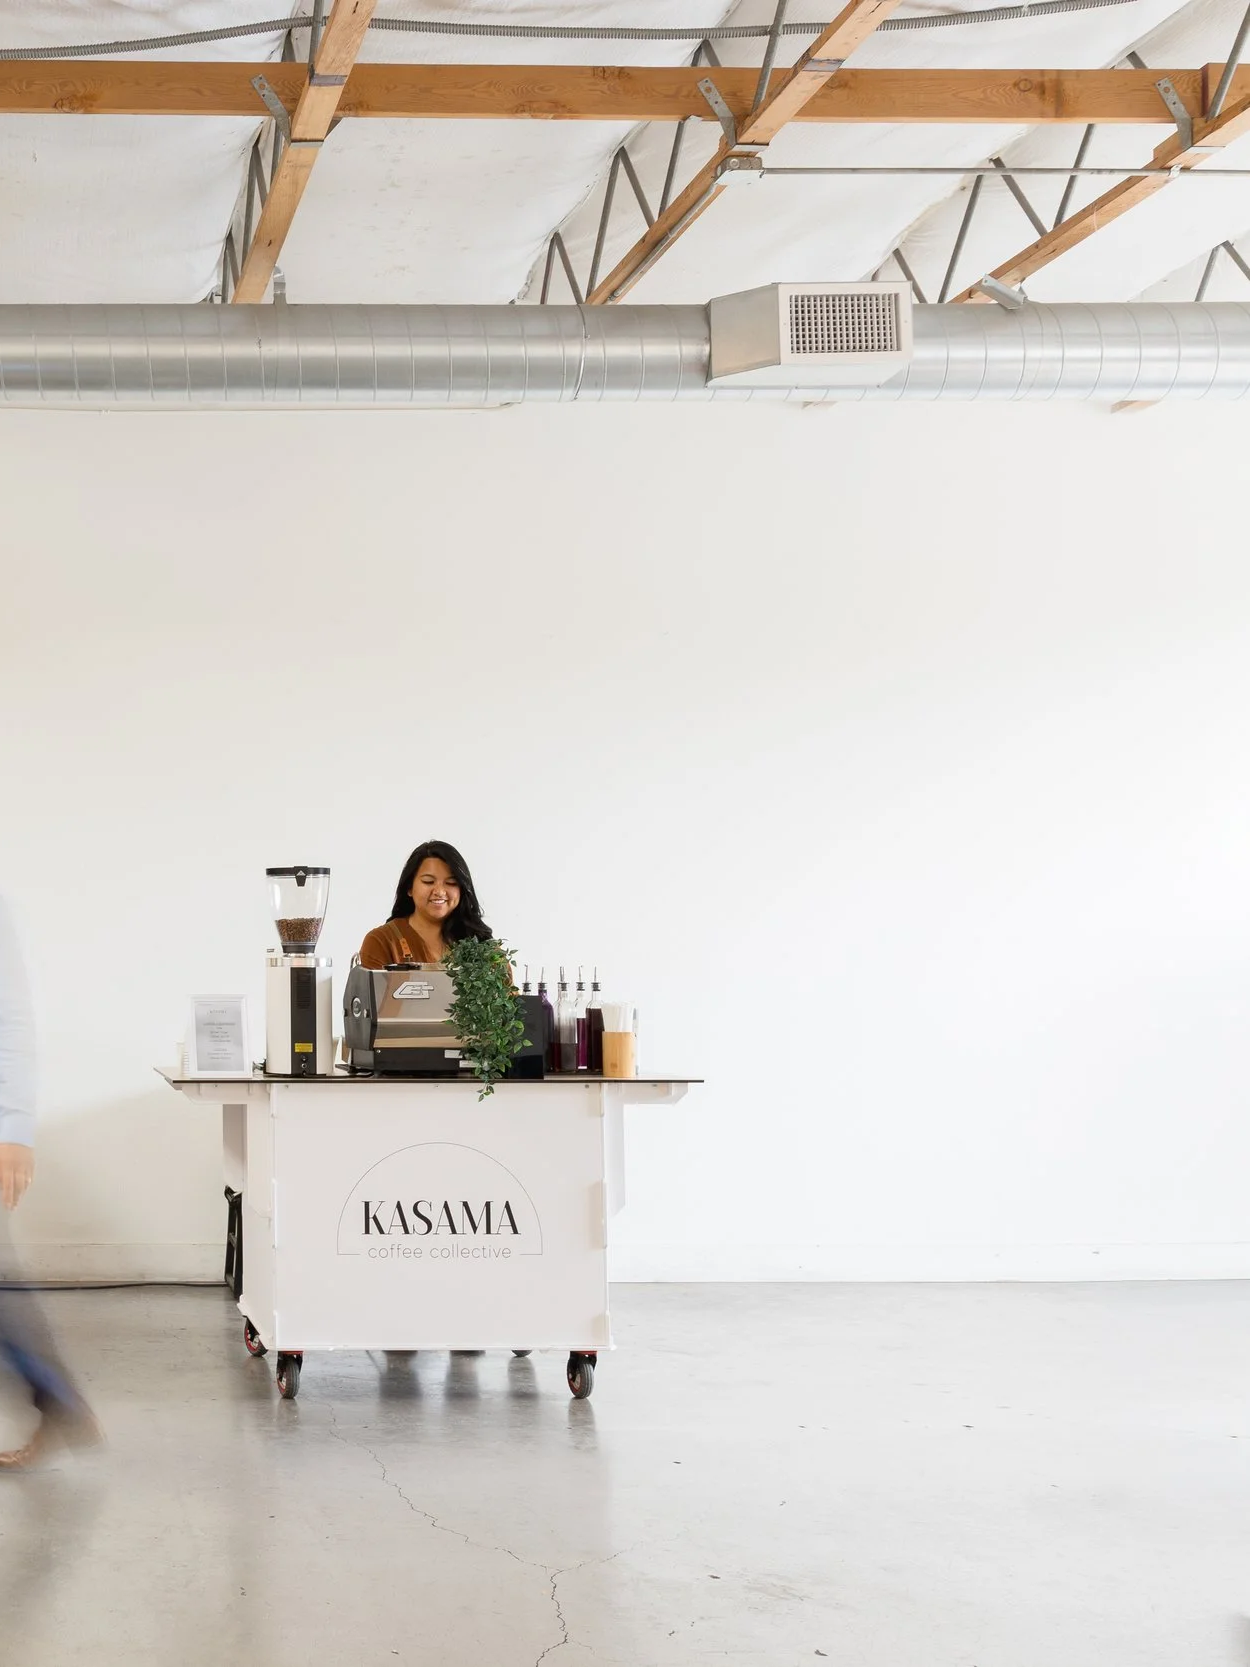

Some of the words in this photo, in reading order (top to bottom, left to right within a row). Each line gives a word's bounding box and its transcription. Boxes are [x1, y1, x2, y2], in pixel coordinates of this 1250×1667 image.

[361, 1199, 522, 1236] KASAMA
[367, 1243, 424, 1259] coffee
[429, 1243, 512, 1259] collective
